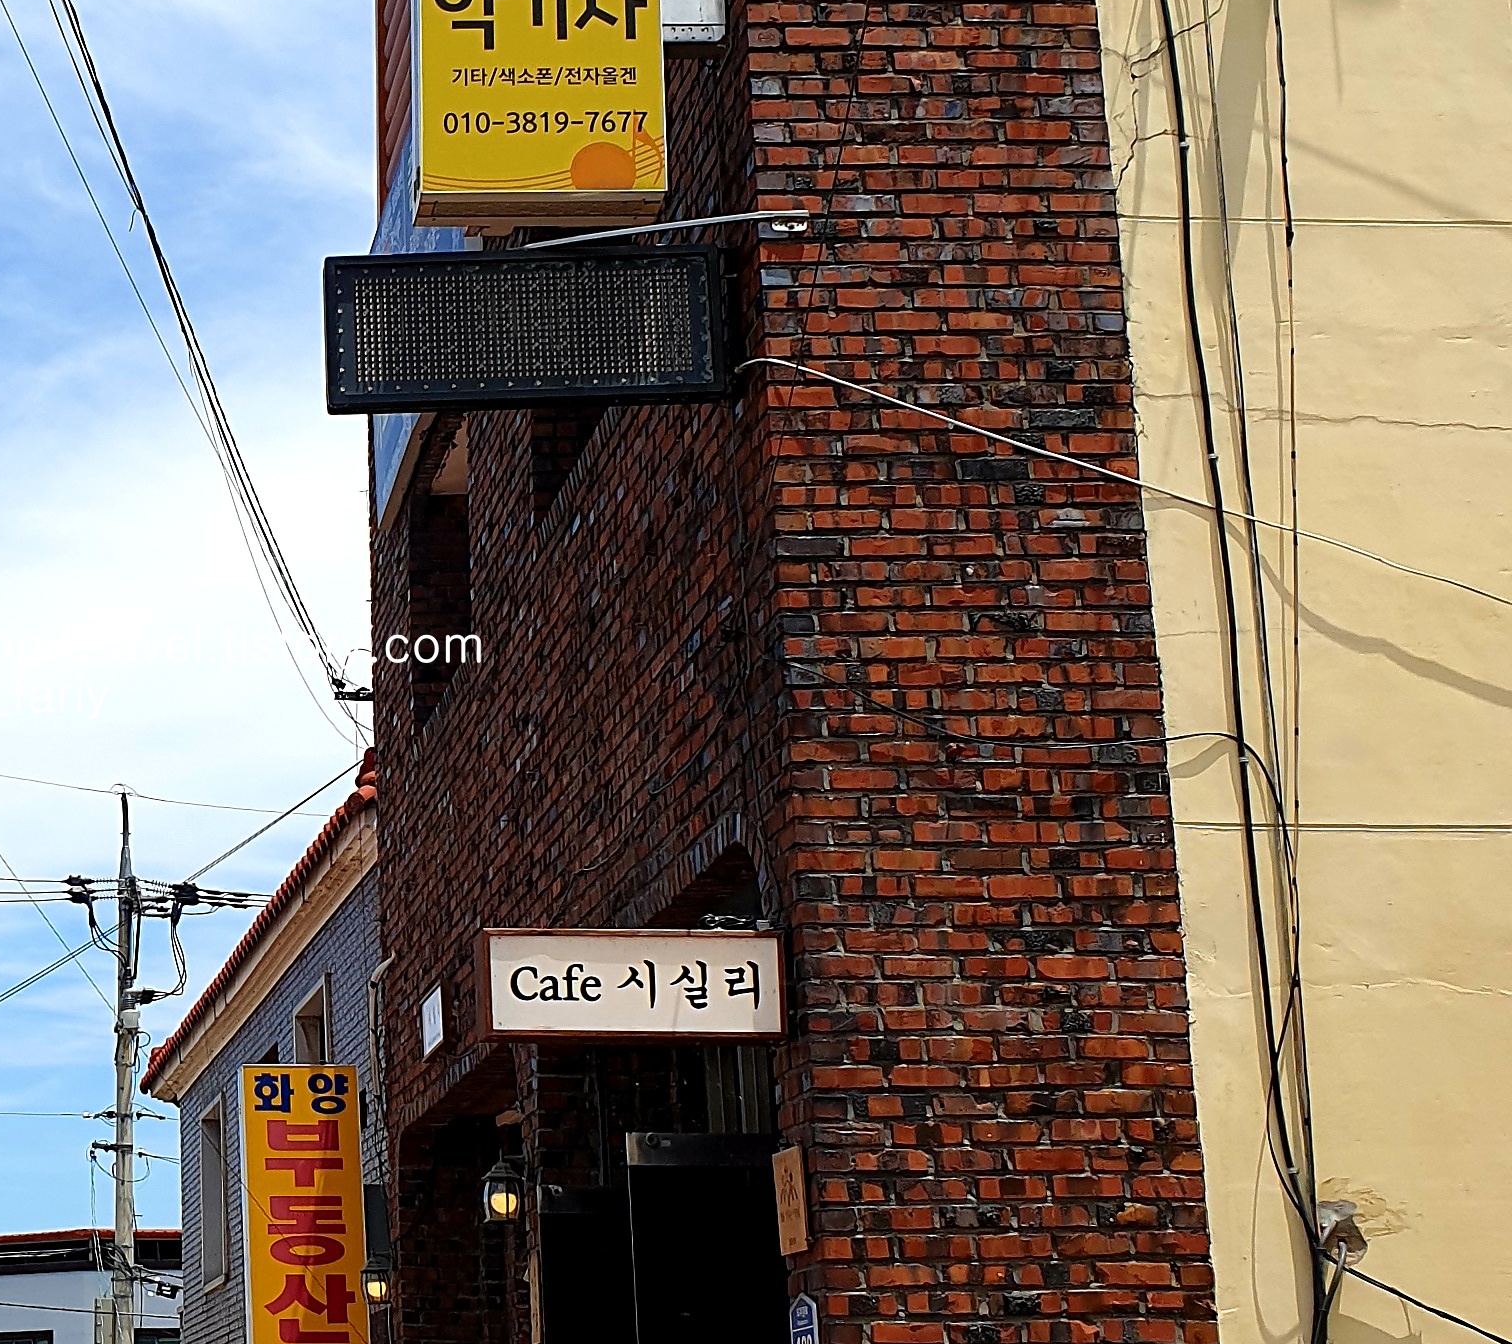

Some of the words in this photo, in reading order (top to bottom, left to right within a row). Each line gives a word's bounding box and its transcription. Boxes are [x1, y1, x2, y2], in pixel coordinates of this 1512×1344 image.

[451, 66, 638, 88] 기타/색소폰/전자올겐
[443, 108, 649, 136] 010-3819-7677
[509, 964, 602, 1003] Cafe
[616, 959, 763, 1009] 시실리
[254, 1072, 349, 1115] 화양
[264, 1119, 356, 1344] 부동산
